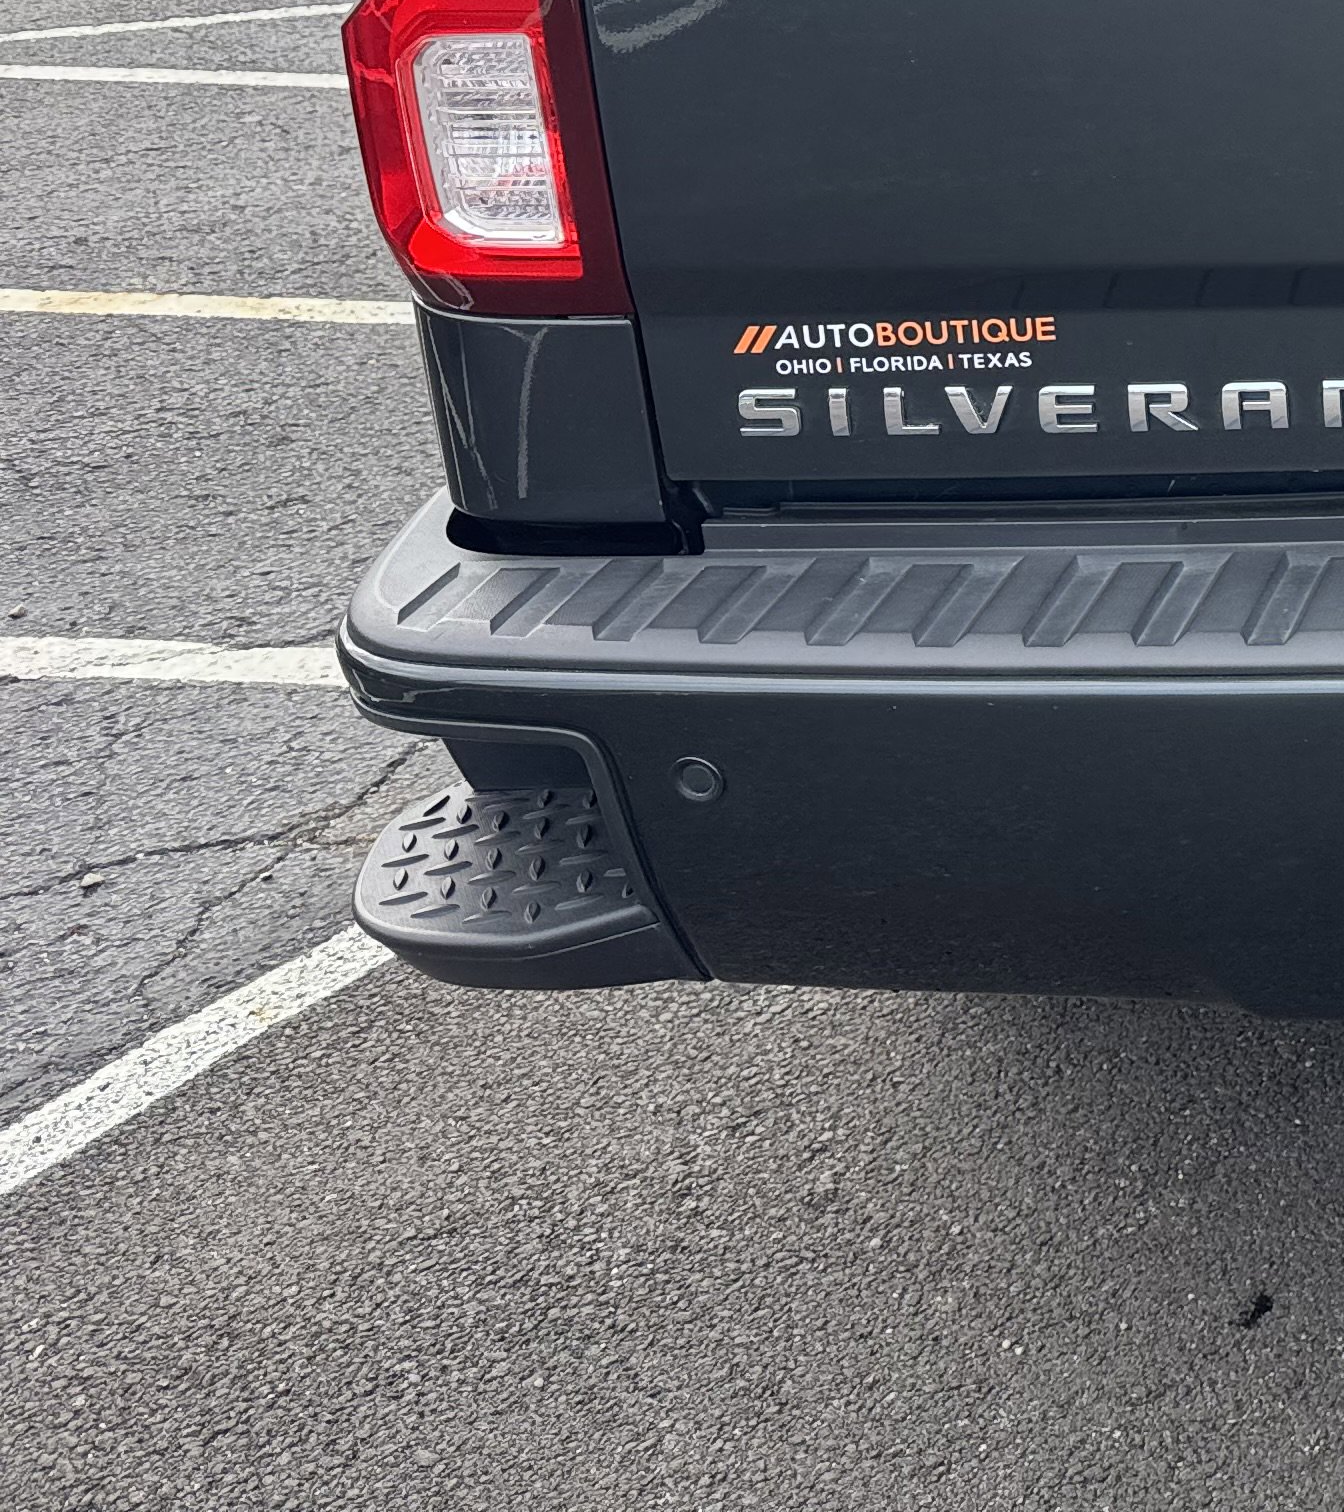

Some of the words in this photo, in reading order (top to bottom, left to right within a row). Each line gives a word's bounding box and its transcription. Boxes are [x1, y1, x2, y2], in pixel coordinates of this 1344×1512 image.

[774, 317, 1057, 350] AUTOBOUTIQUE
[775, 357, 832, 375] OHIO
[849, 355, 944, 374] FLORIDA
[957, 351, 1033, 370] TEXAS
